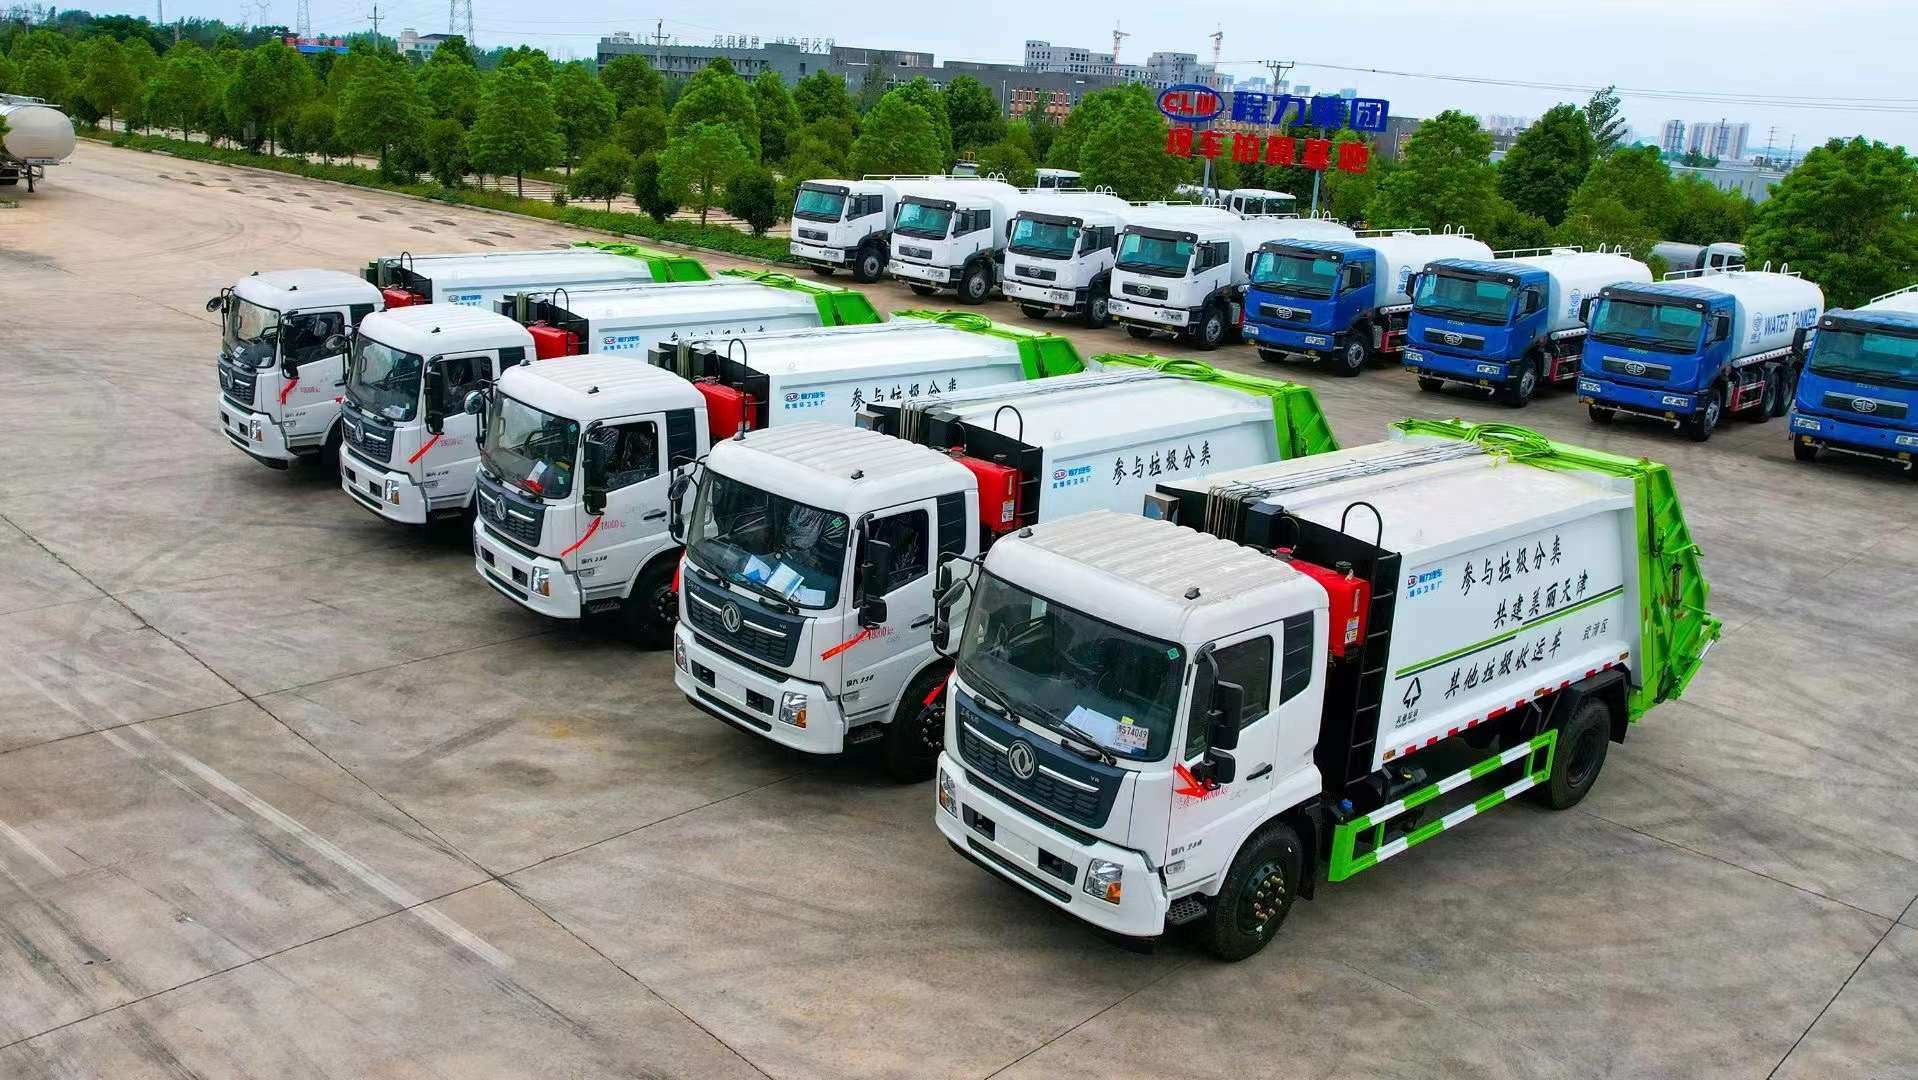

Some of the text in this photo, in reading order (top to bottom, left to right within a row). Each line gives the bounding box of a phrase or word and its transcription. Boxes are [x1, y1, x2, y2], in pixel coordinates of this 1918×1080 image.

[1231, 91, 1390, 132] 程力集团
[1764, 313, 1789, 336] WATER
[1791, 307, 1817, 331] TANKER
[1112, 440, 1212, 486] 参与垃圾分类
[1460, 534, 1562, 596] 参与垃圾分类
[1493, 569, 1589, 630] 共建美丽天津
[1444, 627, 1563, 700] 其他垃圾收运车
